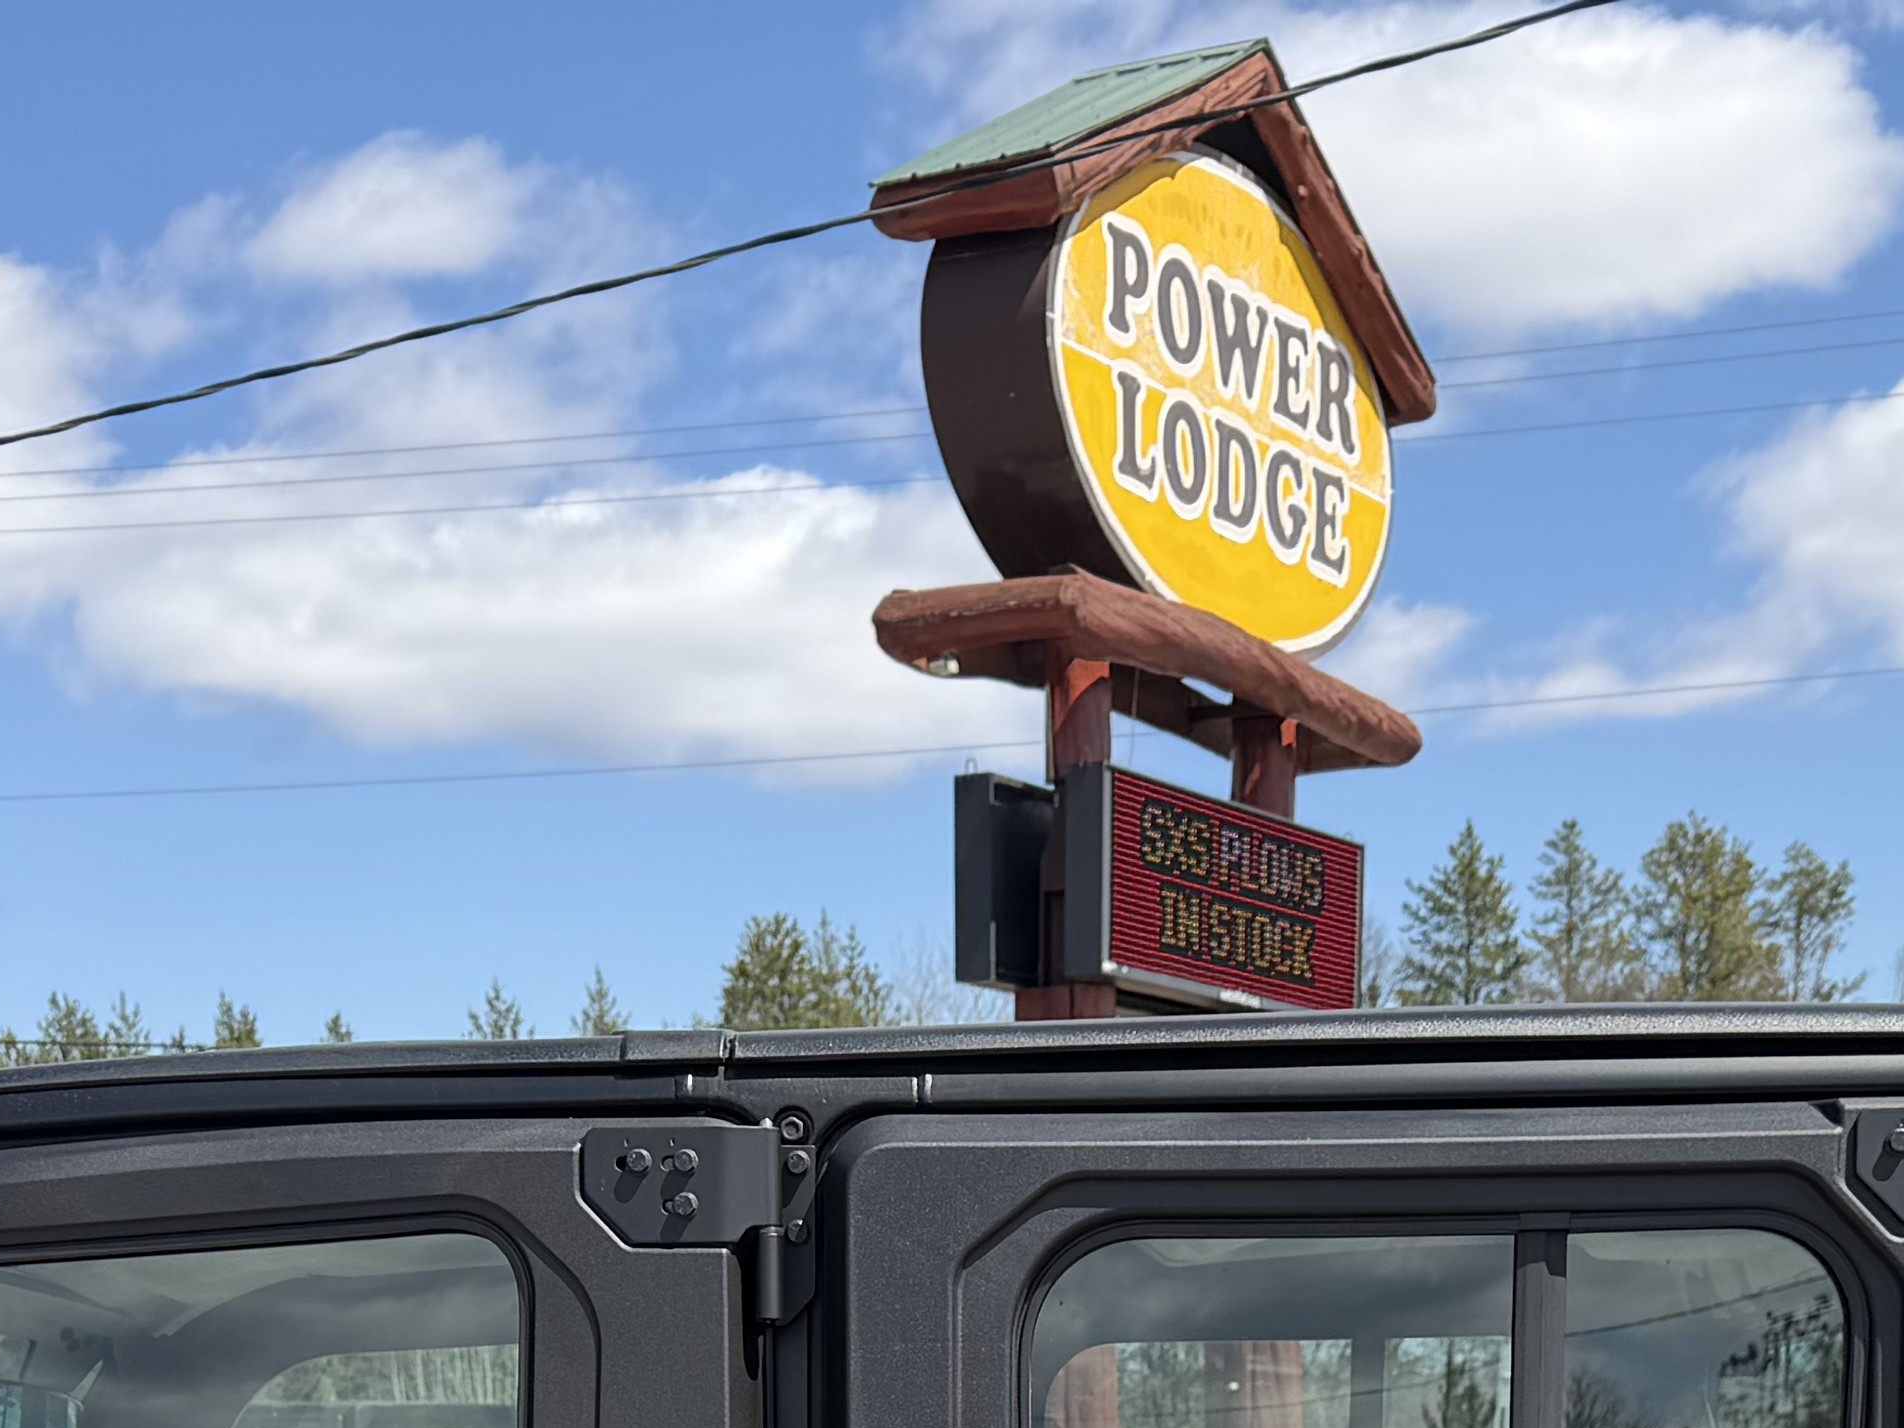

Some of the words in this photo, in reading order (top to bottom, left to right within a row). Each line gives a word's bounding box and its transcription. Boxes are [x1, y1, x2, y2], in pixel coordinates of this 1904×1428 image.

[1106, 216, 1357, 456] POWER
[1116, 370, 1348, 576] LODGE
[1220, 829, 1323, 907] PLOWS
[1210, 902, 1314, 979] STOCK
